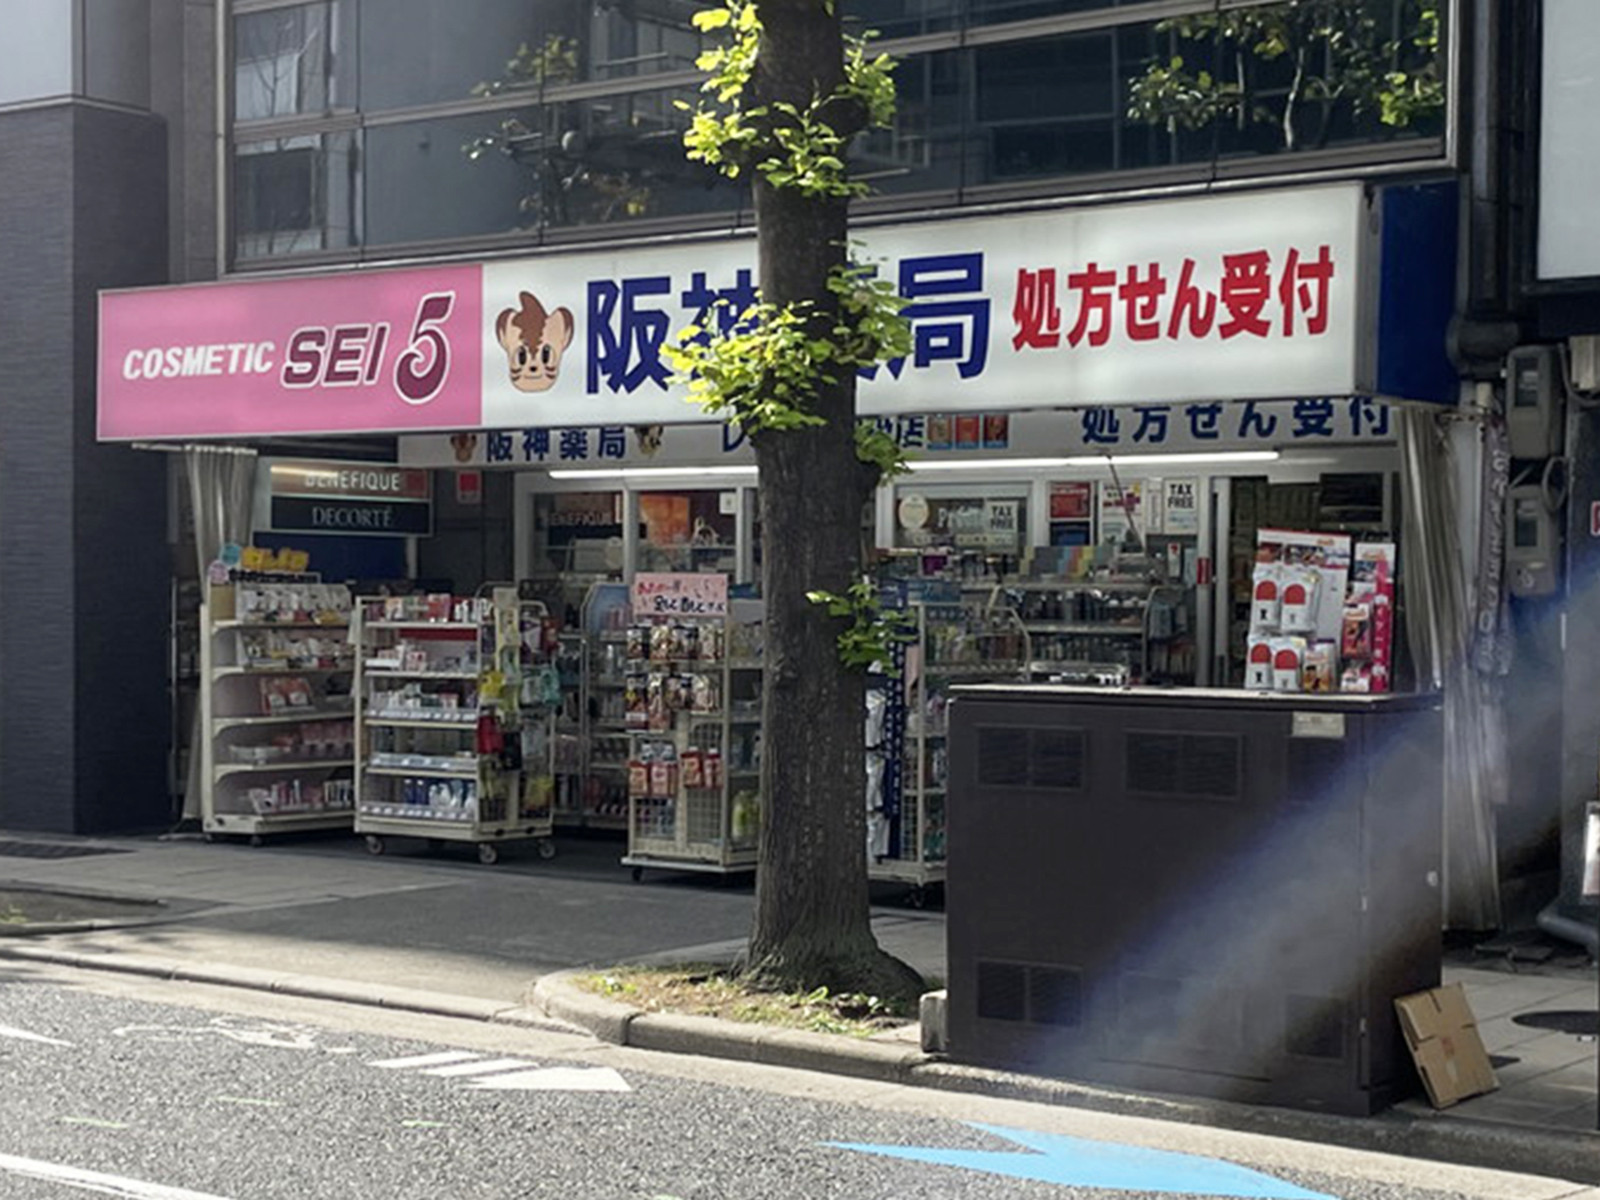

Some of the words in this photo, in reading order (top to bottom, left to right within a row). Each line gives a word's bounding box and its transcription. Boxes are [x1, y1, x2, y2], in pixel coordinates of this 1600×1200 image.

[1012, 245, 1335, 353] 処方せん受付
[586, 251, 992, 395] 阪局
[122, 341, 275, 380] COSMETIC
[280, 321, 390, 389] SEI
[394, 290, 456, 404] 5
[305, 468, 401, 492] BENEFIQUE
[1169, 483, 1193, 496] TAX
[990, 504, 1014, 518] TAX
[1167, 496, 1195, 510] FREE
